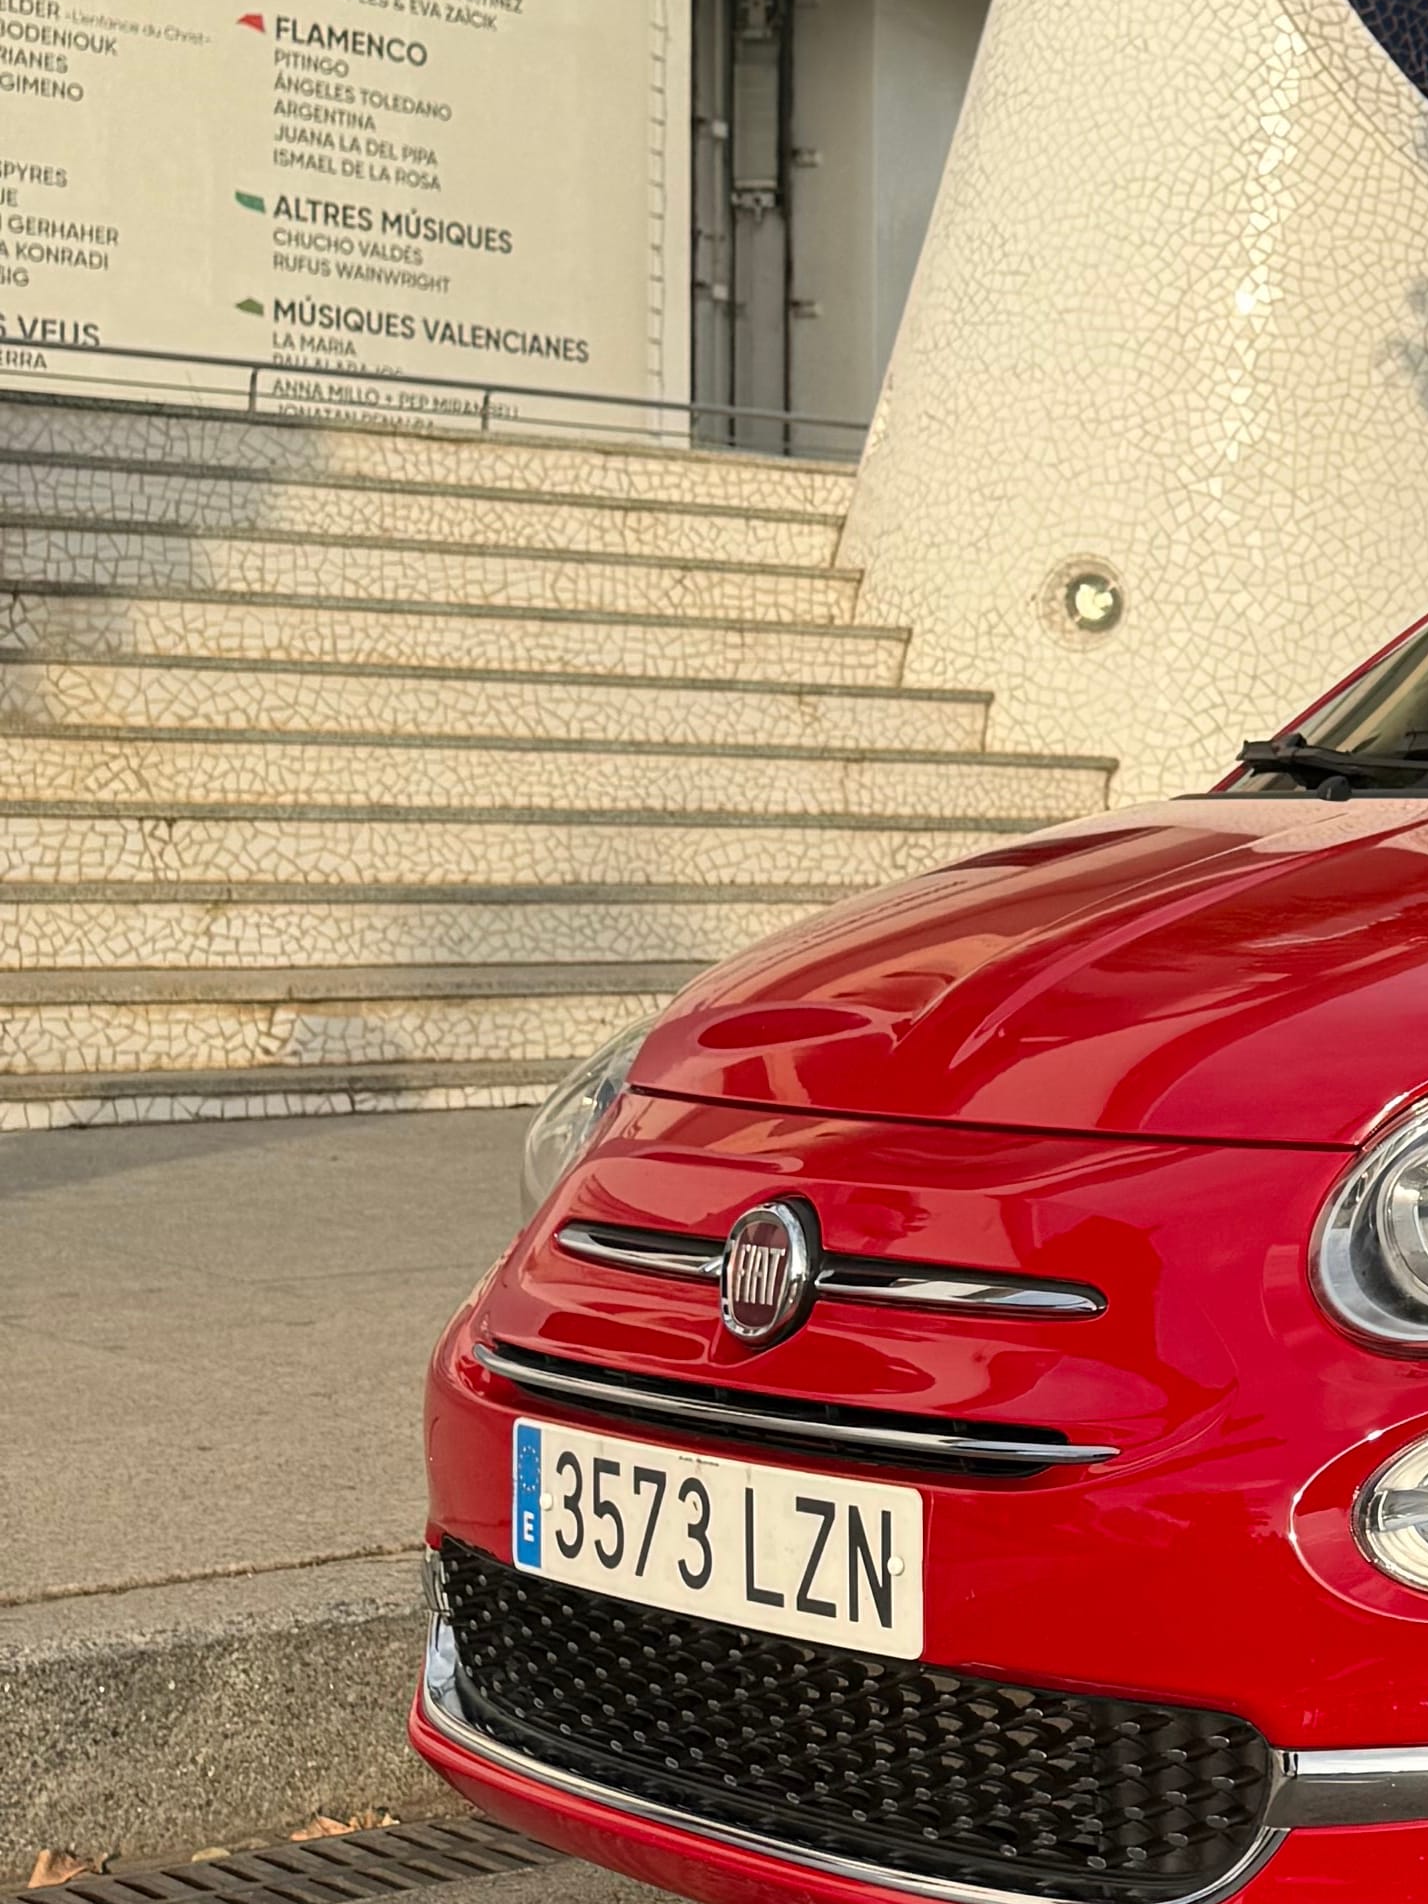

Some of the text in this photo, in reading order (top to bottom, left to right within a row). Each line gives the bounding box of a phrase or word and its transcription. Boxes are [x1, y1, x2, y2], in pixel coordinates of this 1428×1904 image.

[276, 15, 428, 67] FLAMENCO
[274, 49, 350, 78] PITINGO
[0, 71, 84, 102] GIMENO
[274, 71, 452, 122] ÁNGELES TOLEDANO
[274, 98, 376, 132] ARGENTINA
[274, 125, 438, 167] JUANA LA DEL PIPA
[273, 148, 441, 192] ISMAEL DE LA ROSA
[8, 214, 119, 246] GERHAHER
[272, 227, 355, 257] CHUCHO
[273, 195, 513, 254] ALTRES MÚSIQUES
[16, 240, 108, 271] KONRADI
[272, 252, 450, 294] RUFUS WAINWRIGHT
[272, 331, 295, 351] LA
[273, 296, 415, 340] MÚSIQUES
[421, 318, 590, 364] VALENCIANES
[272, 377, 322, 402] ANNA
[736, 1244, 785, 1306] FIAT
[523, 1511, 534, 1543] E
[555, 1450, 893, 1629] 3573 LZN
